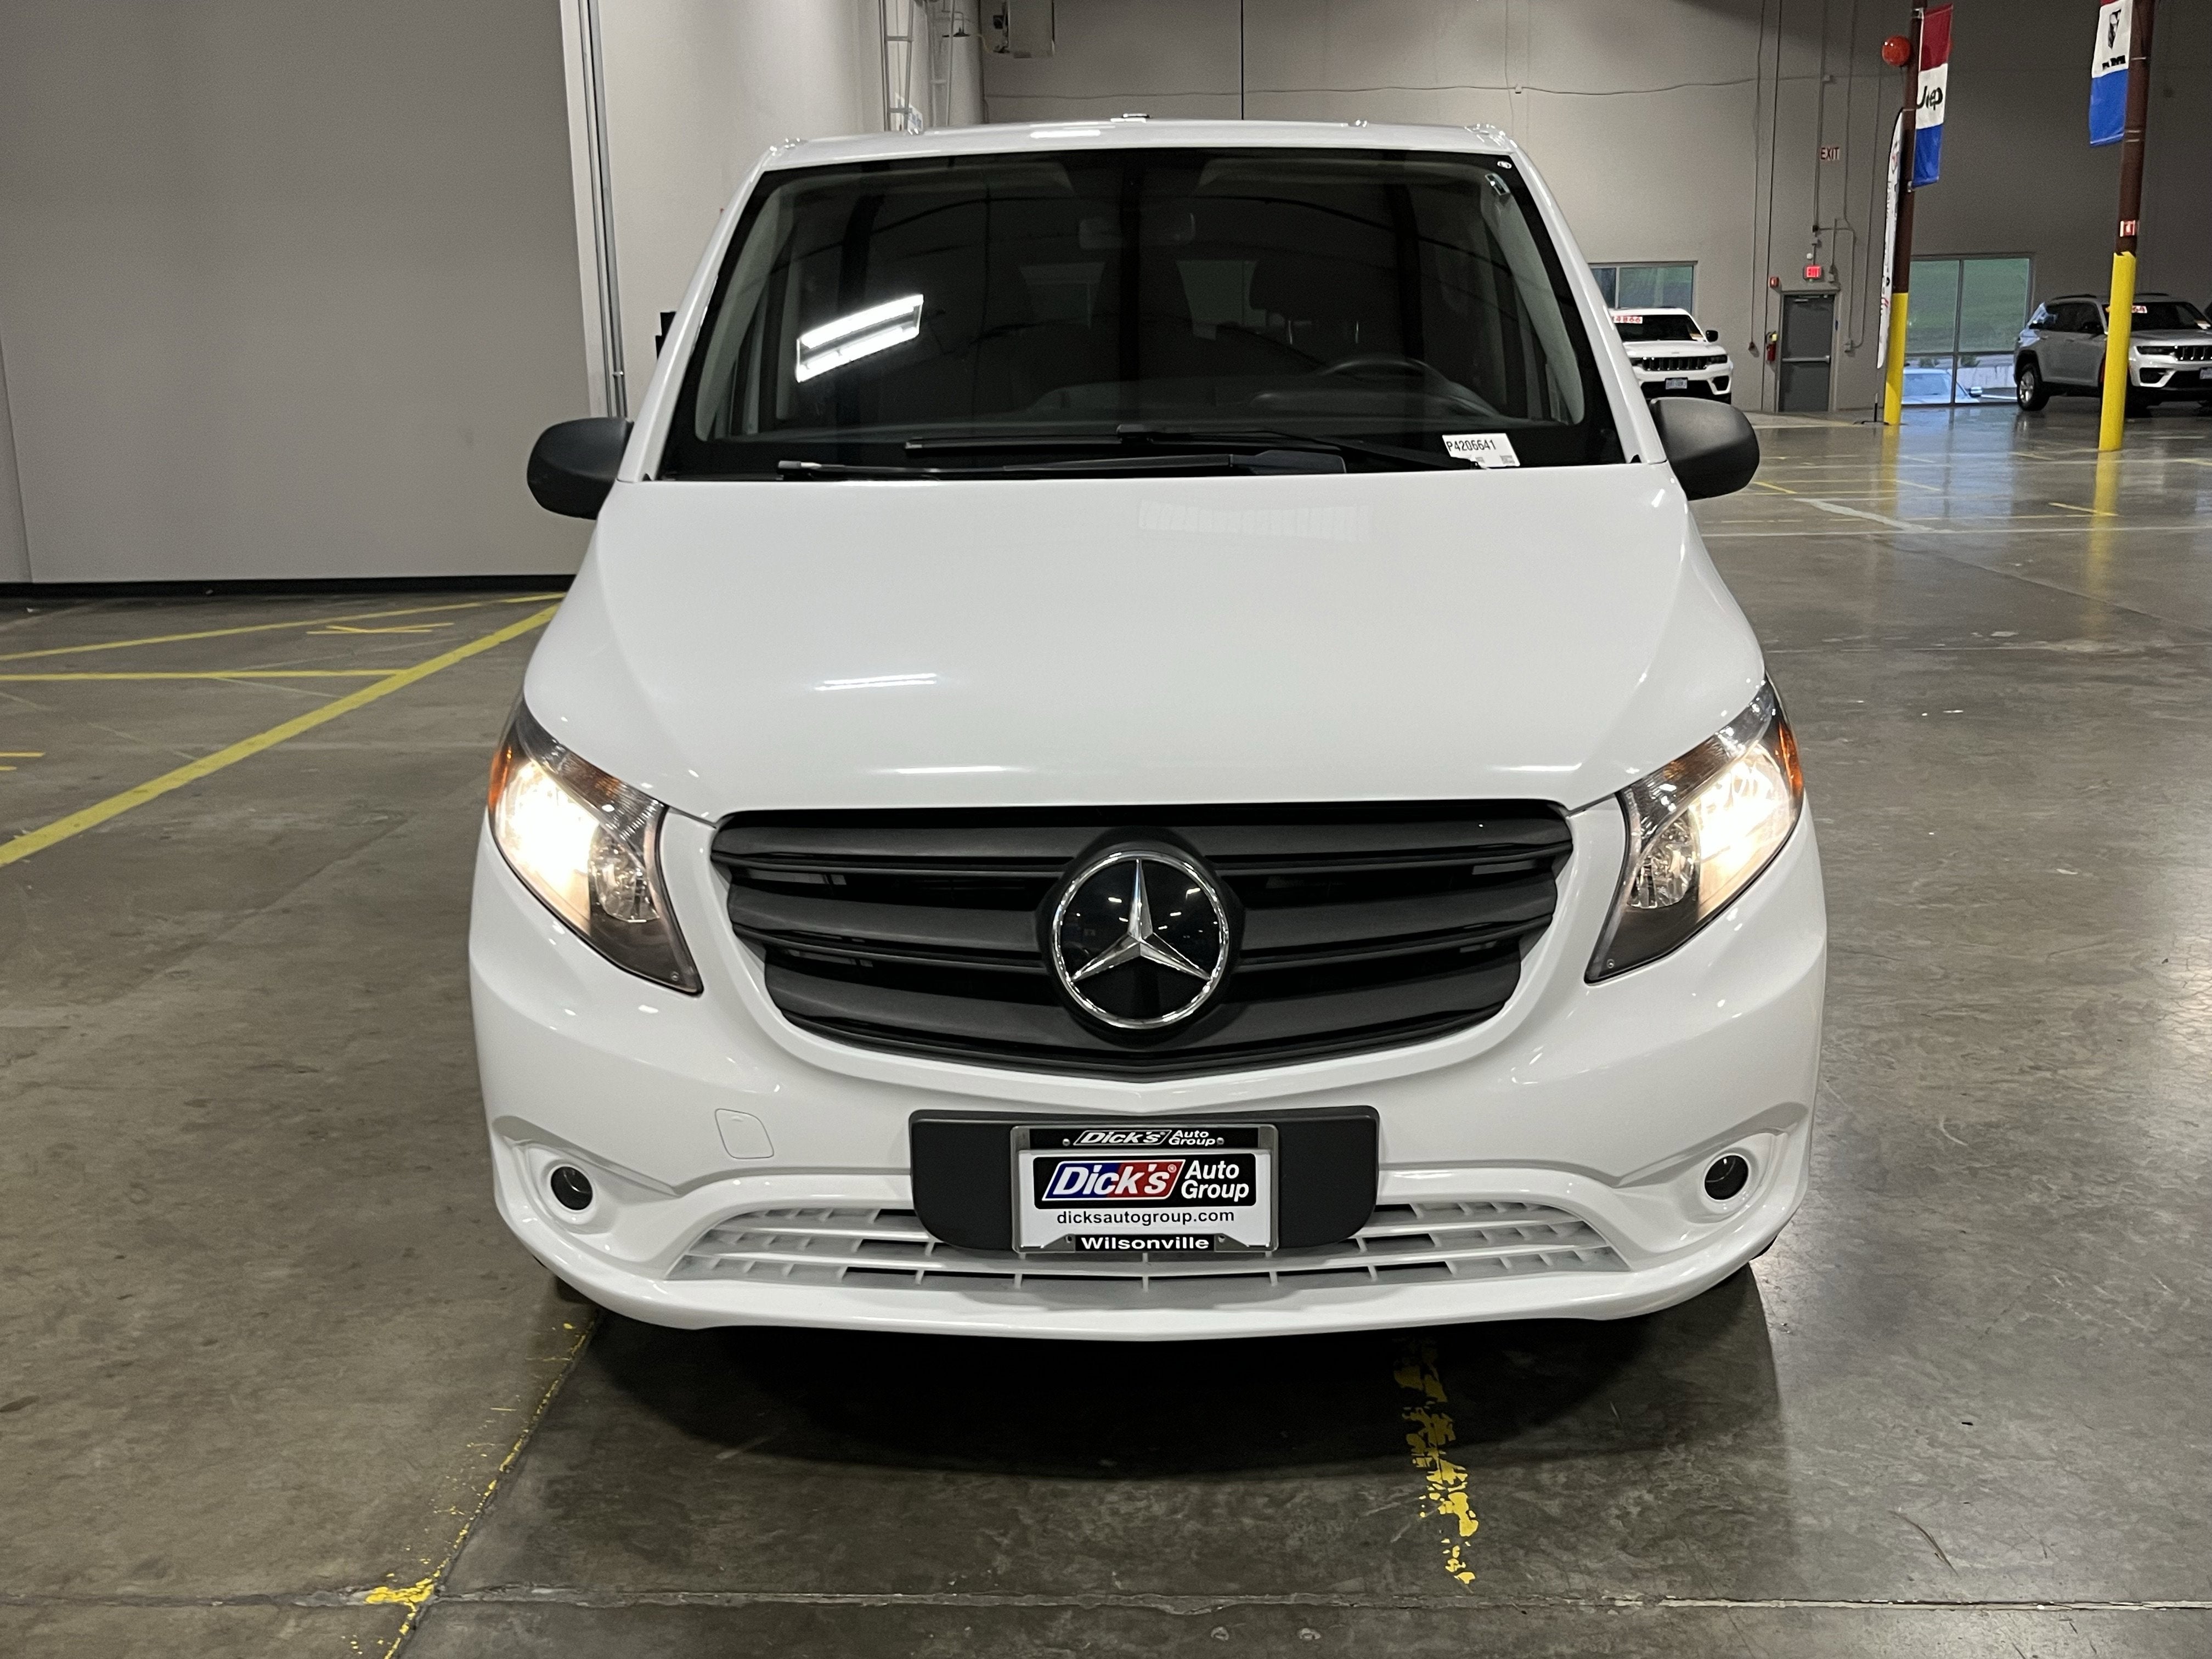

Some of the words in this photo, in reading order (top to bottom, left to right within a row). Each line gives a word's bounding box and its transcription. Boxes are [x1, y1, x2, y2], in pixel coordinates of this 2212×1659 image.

[1821, 147, 1839, 160] EXIT
[1446, 439, 1497, 452] P4206641
[1080, 1131, 1161, 1144] Dick's
[1172, 1130, 1209, 1138] Auto
[1168, 1137, 1216, 1147] Group
[1184, 1160, 1240, 1180] Auto
[1052, 1164, 1170, 1195] Dick's
[1181, 1180, 1250, 1202] Group
[1057, 1211, 1235, 1226] dicksautogroup.com
[1081, 1237, 1210, 1250] Wilsonville
